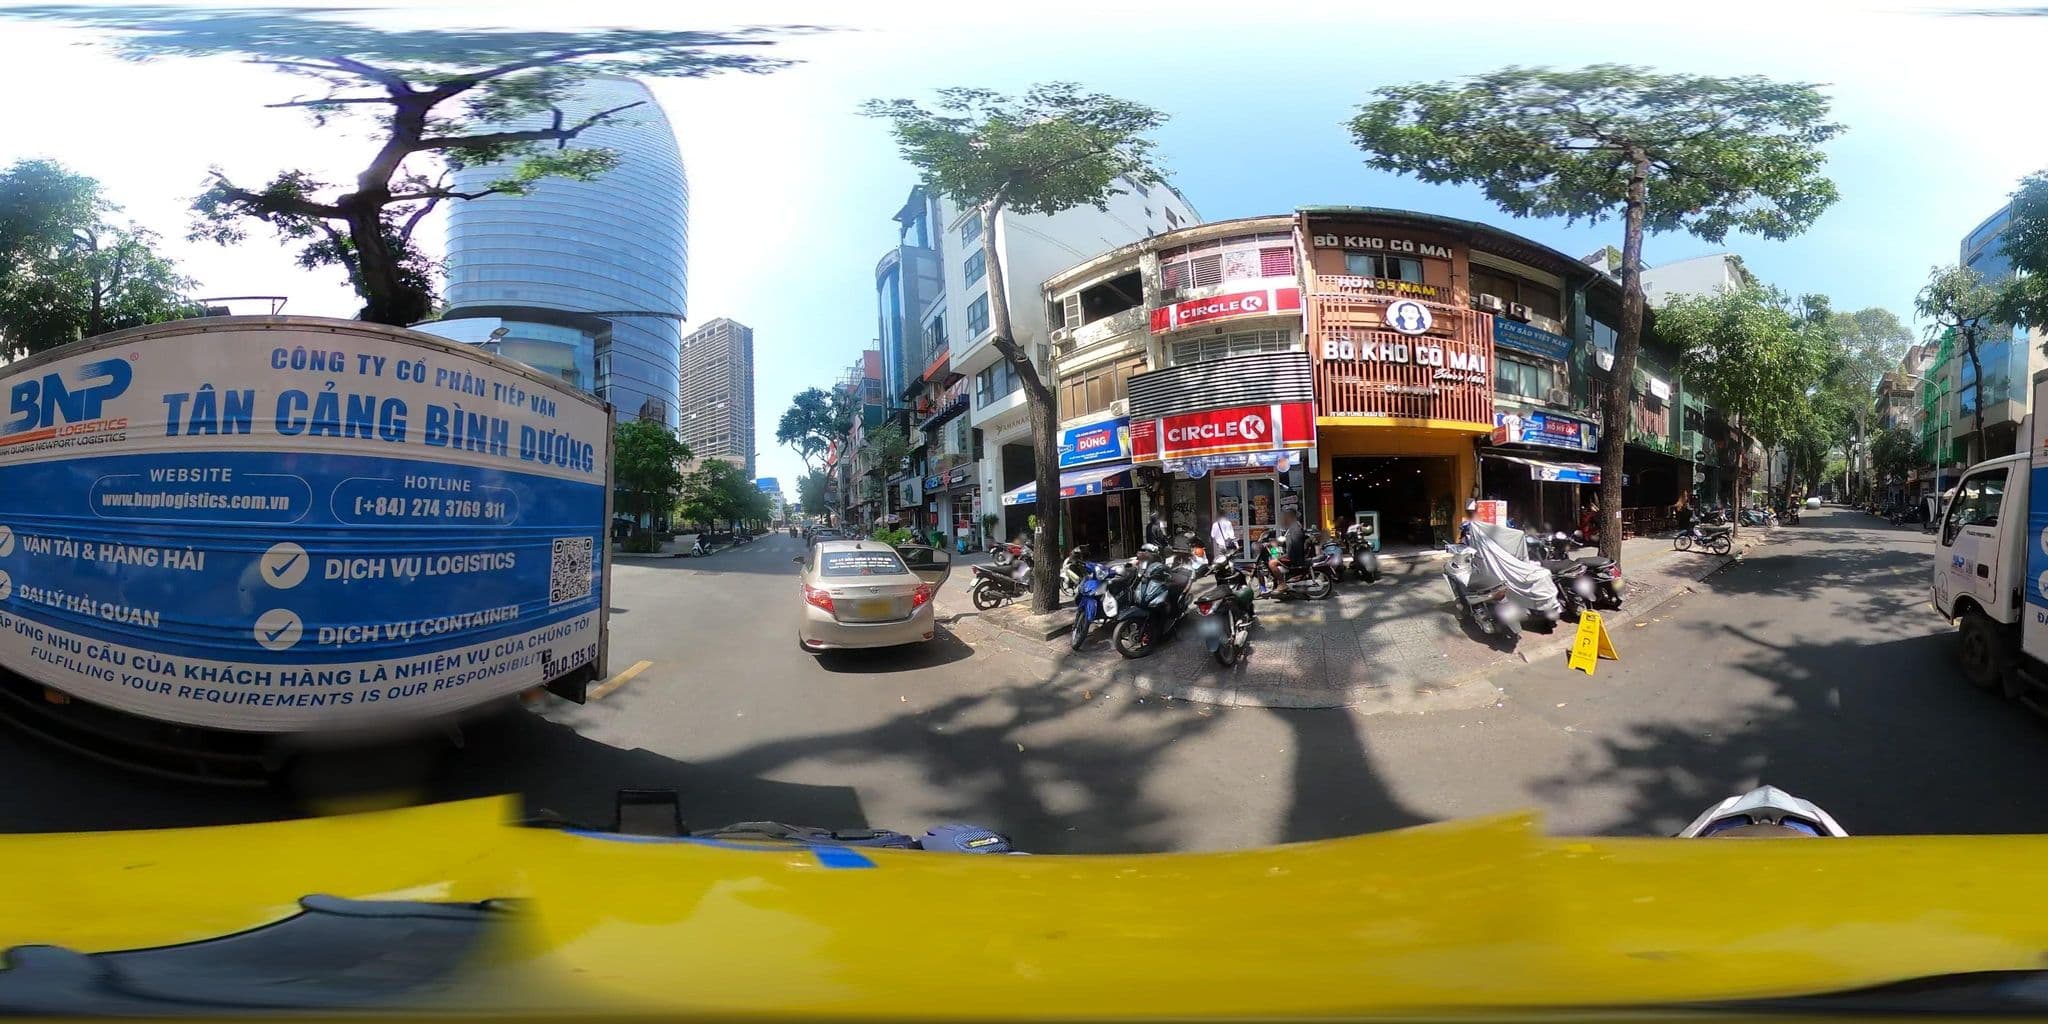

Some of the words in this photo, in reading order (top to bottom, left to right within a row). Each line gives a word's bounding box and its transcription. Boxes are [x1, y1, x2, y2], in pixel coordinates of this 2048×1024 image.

[1313, 233, 1338, 247] BÒ
[1345, 235, 1383, 249] KHO
[1390, 238, 1413, 251] CÔ
[1420, 243, 1452, 258] MAI
[1376, 280, 1395, 290] 35
[1179, 301, 1240, 320] CIRCLE
[1323, 336, 1354, 360] BÒ
[1362, 340, 1408, 364] KHO
[1417, 343, 1443, 366] CÔ
[271, 345, 345, 373] CÔNG
[357, 354, 387, 377] TY
[531, 394, 556, 418] VẬN
[5, 358, 132, 434] BNP
[59, 418, 128, 437] LOGISTICS
[163, 383, 255, 437] TÂN
[274, 381, 408, 443] CẢNG
[424, 402, 509, 457] BÌNH
[519, 425, 593, 473] DƯƠNG
[1168, 422, 1238, 442] CIRCLE
[1242, 416, 1265, 439] K
[35, 438, 76, 452] NEWPORT
[77, 432, 126, 447] LOGISTICS
[150, 468, 232, 483] WEBSITE
[404, 475, 471, 492] HOTLINE
[102, 491, 289, 510] www.bnplogistics.com.vn
[355, 496, 404, 516] (+84)
[412, 498, 439, 517] 274
[446, 500, 480, 518] 3769
[485, 501, 505, 518] 311
[23, 535, 50, 557] VẬN
[82, 543, 95, 560] &
[99, 542, 159, 567] HÀNG
[163, 545, 205, 571] HẢI
[325, 559, 385, 584] DỊCH
[391, 557, 420, 581] VỤ
[426, 552, 515, 576] LOGISTICS
[101, 602, 159, 628] QUAN
[319, 624, 378, 648] DỊCH
[385, 622, 416, 643] VỤ
[420, 605, 519, 634] CONTAINER
[48, 633, 82, 654] NHU
[132, 654, 176, 677] CỦA
[184, 664, 271, 687] KHÁCH
[280, 665, 358, 686] HÀNG
[359, 664, 388, 683] LÀ
[395, 655, 460, 679] NHIỆM
[467, 649, 489, 669] VỤ
[495, 638, 524, 659] CỦA
[528, 624, 571, 648] CHÚNG
[31, 647, 115, 682] FULFILLING
[121, 673, 172, 695] YOUR
[178, 686, 353, 708] REQUIREMENTS
[361, 689, 380, 702] IS
[388, 683, 427, 699] OUR
[434, 652, 549, 692] RESPONSIBILIT
